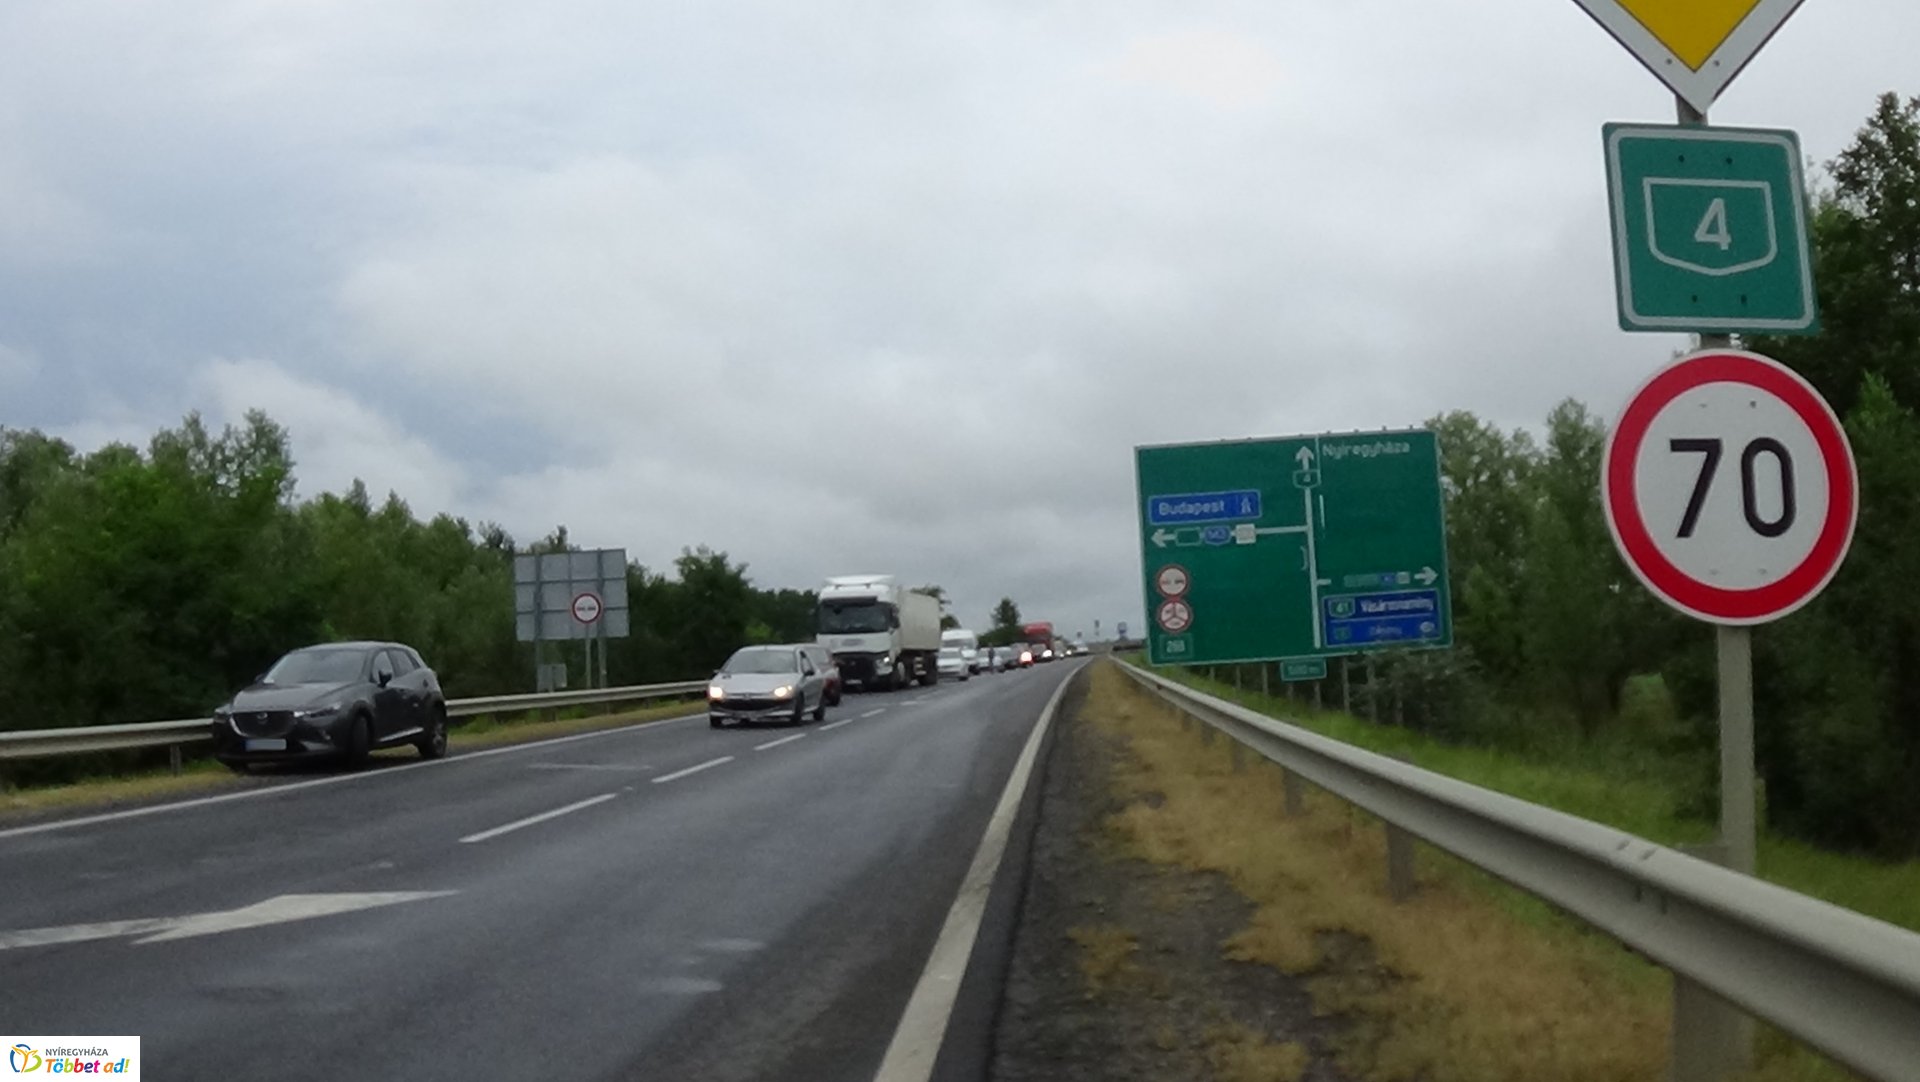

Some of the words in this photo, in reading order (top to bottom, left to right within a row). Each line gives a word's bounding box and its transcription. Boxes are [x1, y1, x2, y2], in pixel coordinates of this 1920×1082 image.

[1694, 197, 1732, 251] 4
[1158, 500, 1225, 516] Budapest
[1669, 436, 1797, 539] 70
